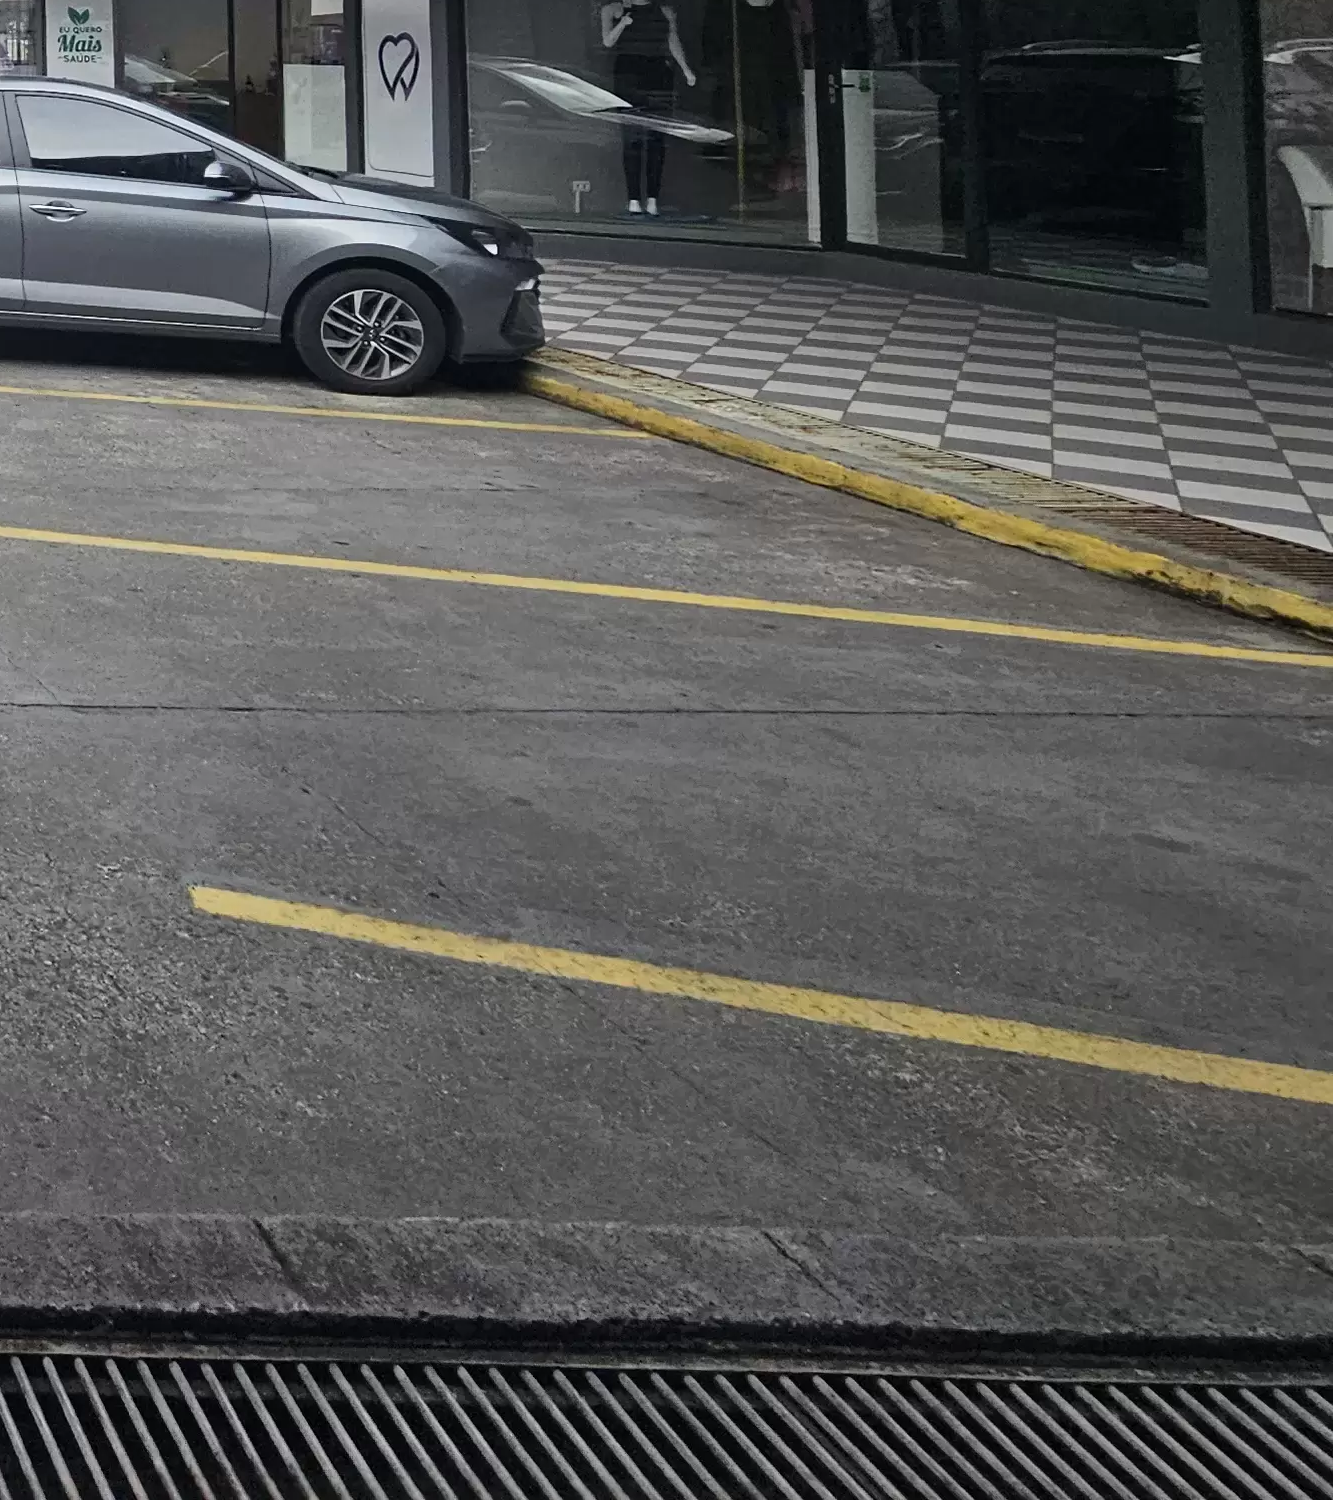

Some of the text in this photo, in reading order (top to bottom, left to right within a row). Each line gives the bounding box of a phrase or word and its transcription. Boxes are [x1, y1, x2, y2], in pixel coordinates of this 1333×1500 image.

[59, 26, 103, 35] EU QUERO
[57, 34, 102, 52] Mais
